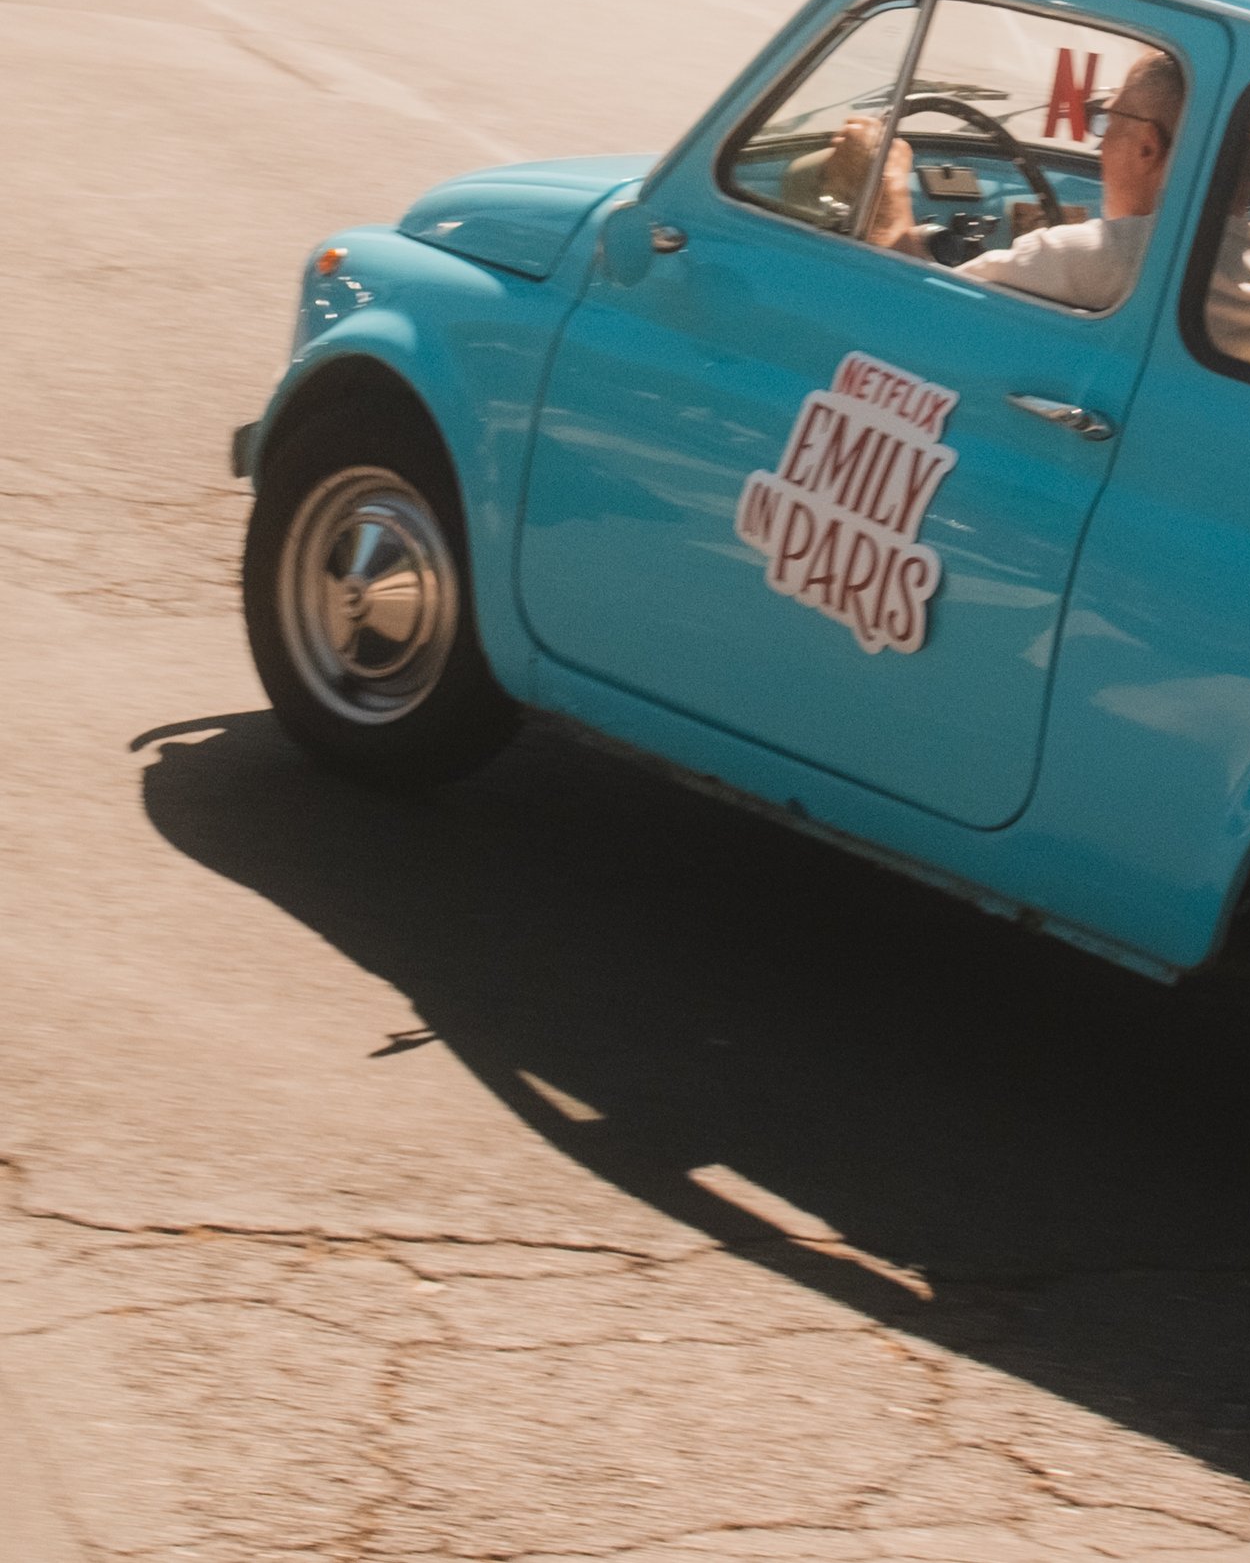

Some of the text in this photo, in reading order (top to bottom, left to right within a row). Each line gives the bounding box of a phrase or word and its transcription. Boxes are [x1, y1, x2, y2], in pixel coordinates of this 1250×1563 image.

[1042, 48, 1102, 142] N
[834, 357, 950, 434] NETFLIX
[743, 482, 783, 542] IN
[784, 401, 942, 534] EMILY
[775, 501, 929, 643] PARIS
